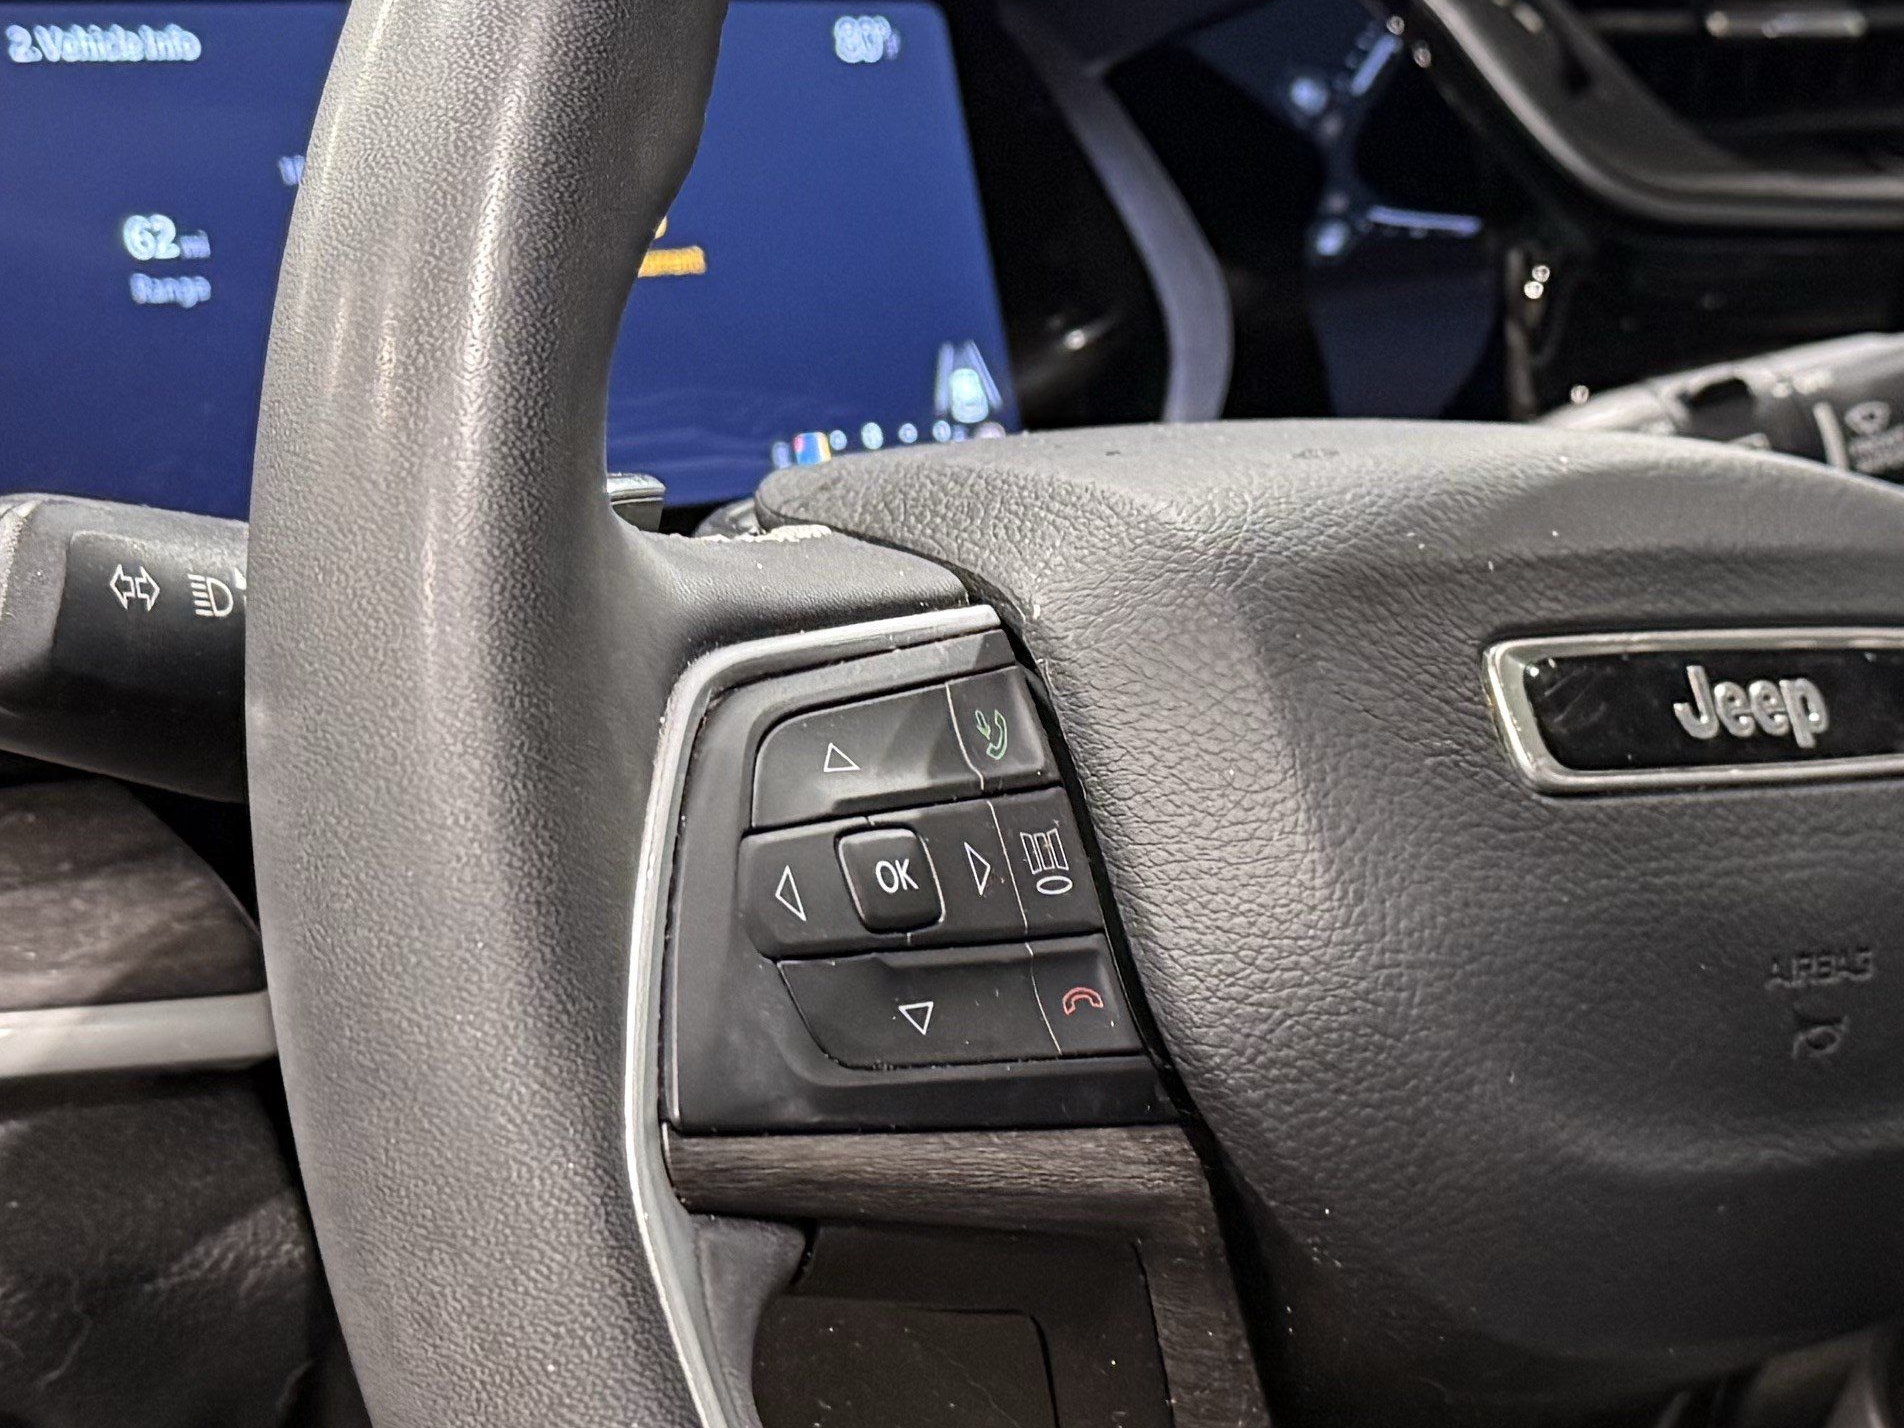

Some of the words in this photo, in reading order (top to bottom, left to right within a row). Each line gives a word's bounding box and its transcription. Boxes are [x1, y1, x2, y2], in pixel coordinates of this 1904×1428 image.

[123, 214, 180, 260] 62
[1673, 665, 1829, 748] Jeep
[875, 858, 919, 893] OK
